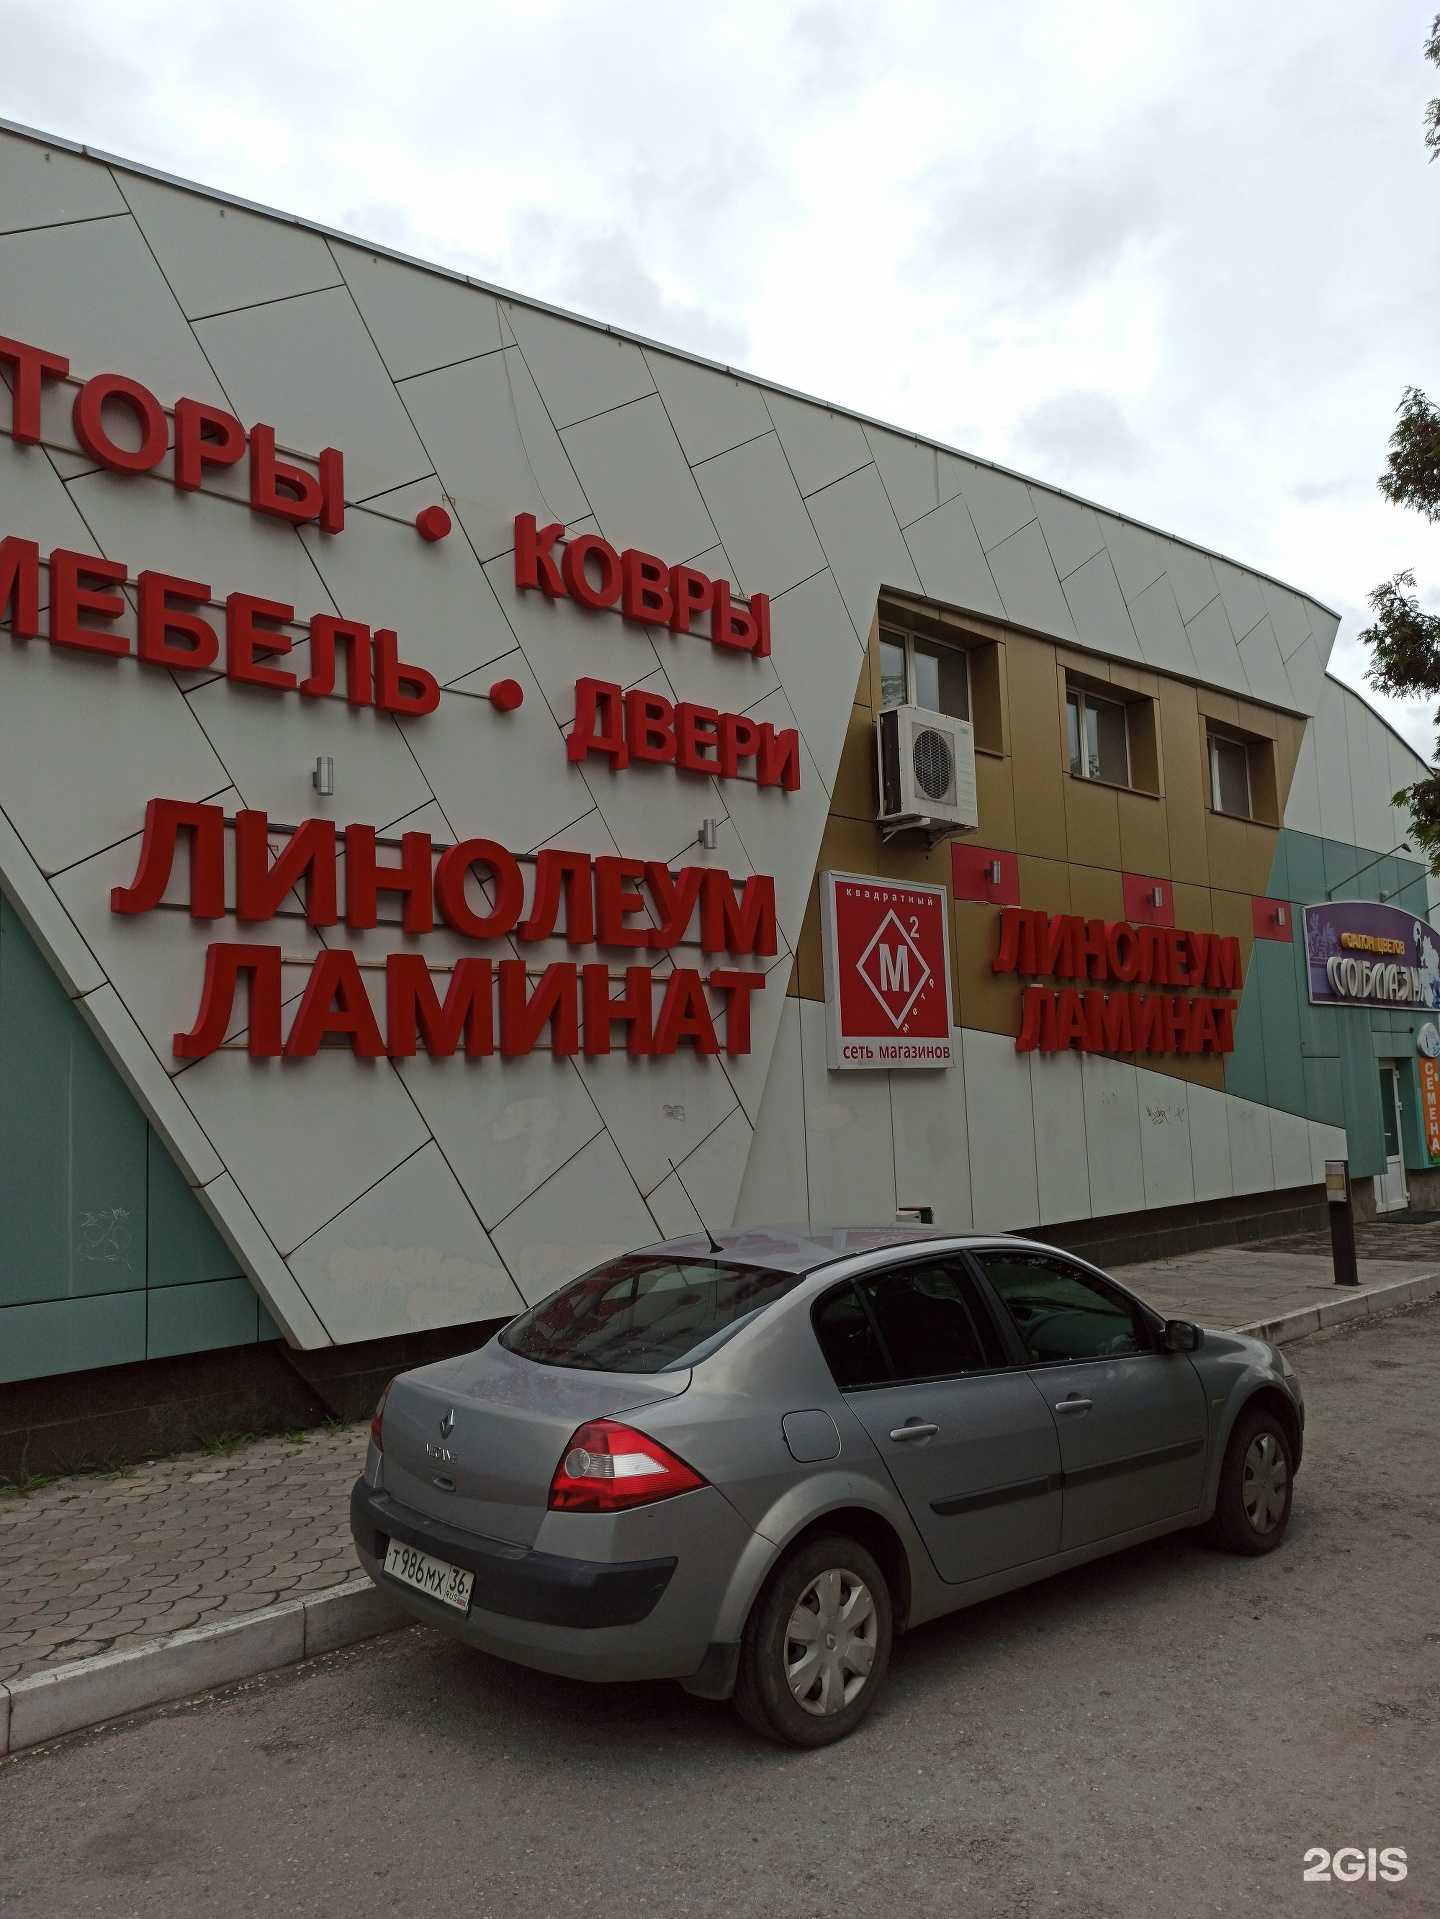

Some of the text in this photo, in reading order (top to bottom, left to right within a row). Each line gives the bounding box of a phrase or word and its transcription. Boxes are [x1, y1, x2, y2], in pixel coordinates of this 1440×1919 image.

[514, 512, 771, 658] КОВРЫ
[567, 677, 800, 792] ДВЕРИ
[110, 798, 777, 957] ЛИНОЛЕУМ
[846, 888, 934, 907] квадратный
[992, 907, 1243, 990] ЛИНОЛЕУМ
[173, 942, 766, 1058] ЛАМИНАТ
[1015, 987, 1238, 1054] ЛАМИНАТ
[843, 1044, 951, 1060] сеть магазинов
[1424, 1061, 1440, 1153] СЕМЕНА
